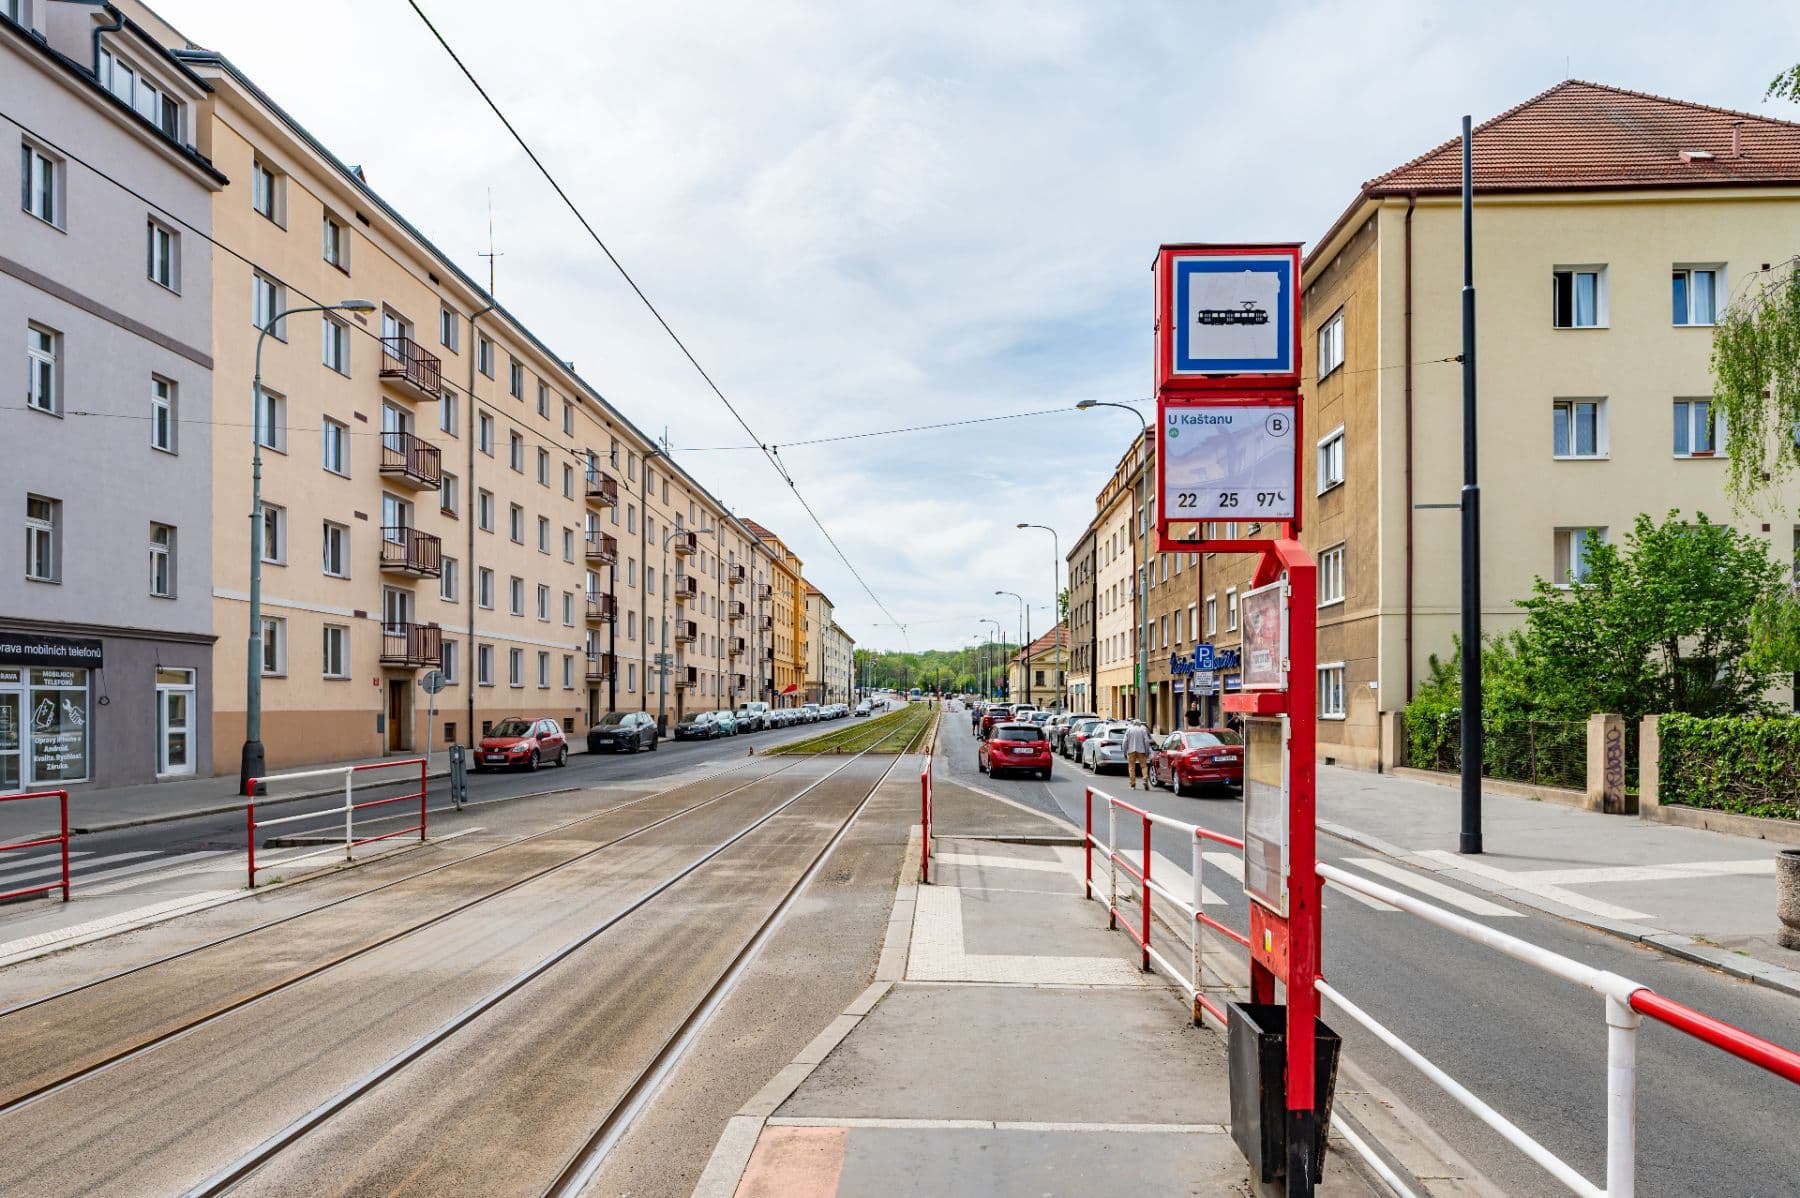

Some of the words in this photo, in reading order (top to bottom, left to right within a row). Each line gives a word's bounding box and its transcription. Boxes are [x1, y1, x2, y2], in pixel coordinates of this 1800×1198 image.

[1168, 415, 1177, 424] U
[1181, 413, 1233, 425] Kaštanu
[1273, 419, 1282, 431] B
[1178, 493, 1197, 508] 22
[1219, 493, 1239, 508] 25
[1256, 492, 1276, 507] 97
[0, 644, 22, 653] rava
[24, 644, 66, 656] mobilních
[69, 647, 101, 657] telefonů
[1199, 647, 1210, 662] P
